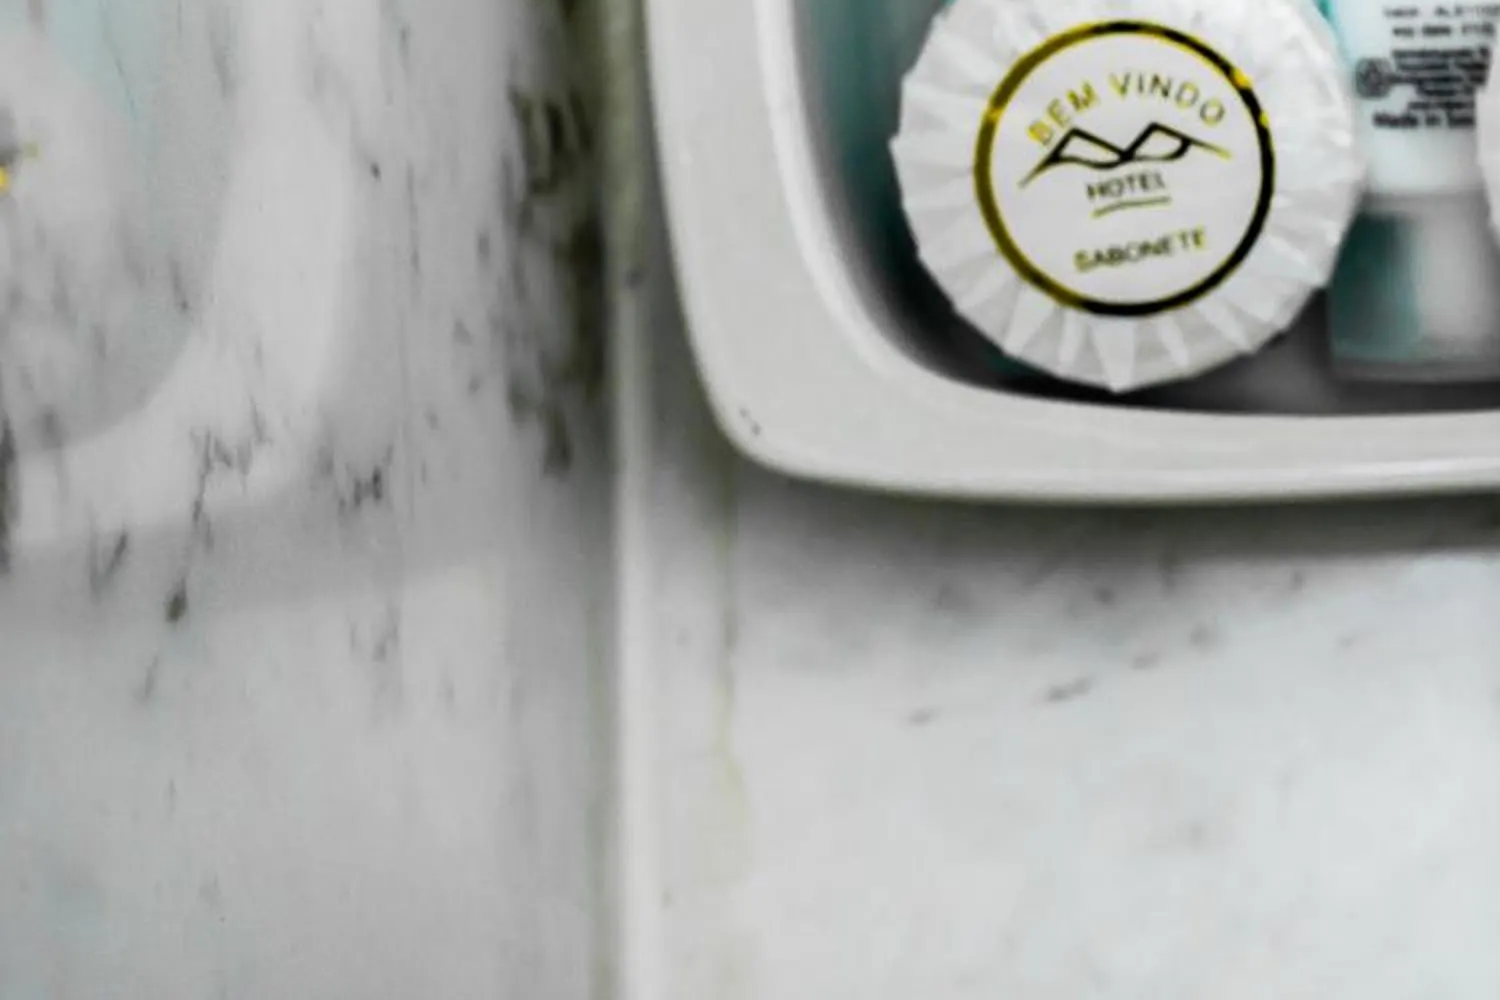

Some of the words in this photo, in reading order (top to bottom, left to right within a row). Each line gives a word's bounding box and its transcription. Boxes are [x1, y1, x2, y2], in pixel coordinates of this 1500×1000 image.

[1027, 81, 1100, 146] BEM
[1109, 70, 1226, 127] VINDO
[1085, 172, 1167, 200] HOTEL
[1074, 227, 1206, 272] SABONETE
